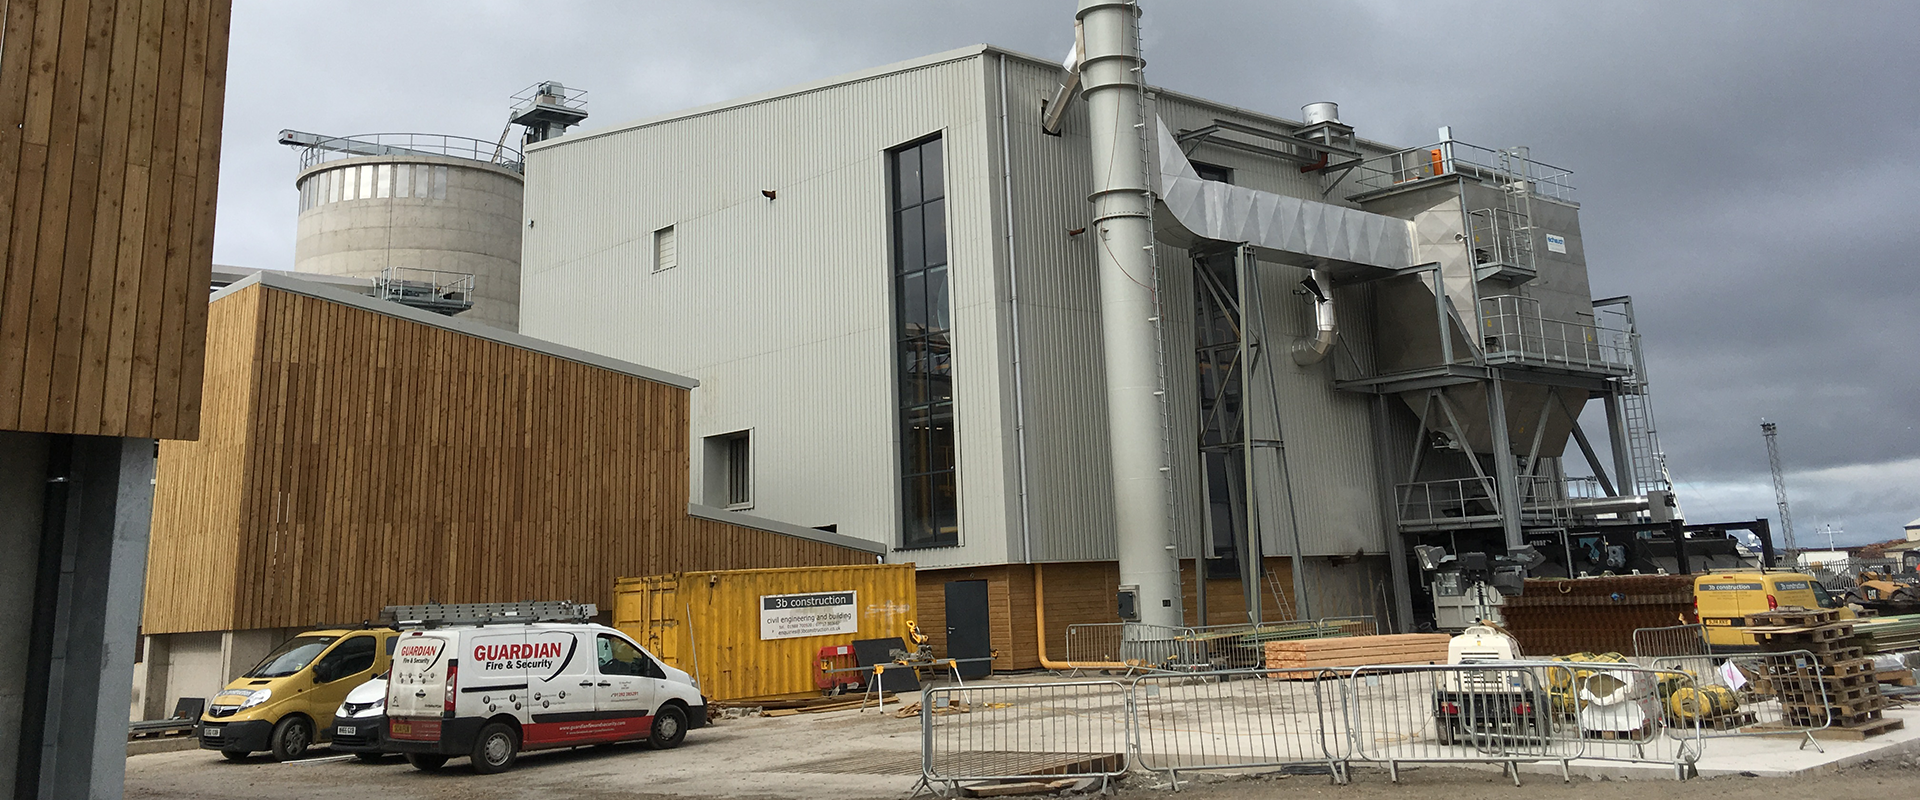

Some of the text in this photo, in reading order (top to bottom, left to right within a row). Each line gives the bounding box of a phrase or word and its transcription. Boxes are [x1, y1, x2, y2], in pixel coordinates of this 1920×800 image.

[1868, 590, 1876, 599] CAT
[775, 595, 846, 608] 3b construction
[781, 614, 815, 624] engineering
[828, 612, 852, 621] building
[401, 646, 437, 656] GUARDIAN
[474, 642, 562, 661] GUARDIAN
[485, 659, 553, 670] Fire & Security
